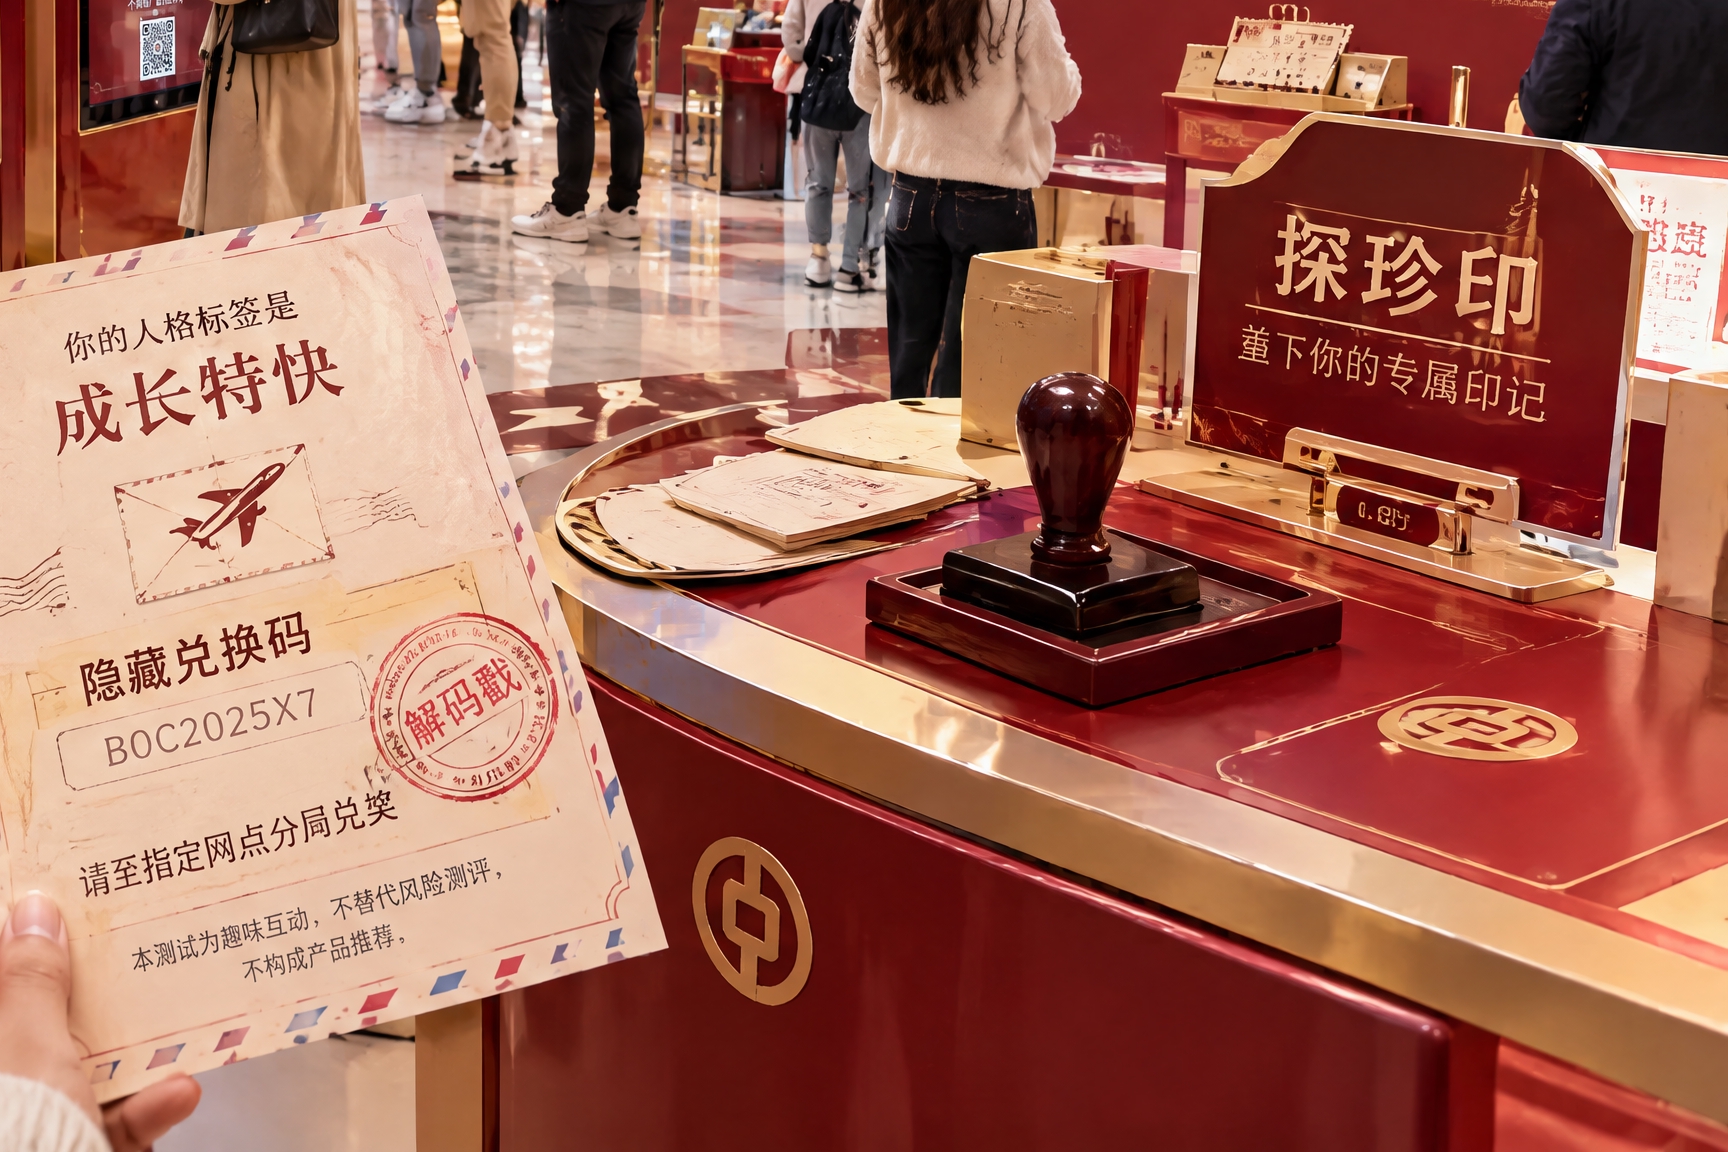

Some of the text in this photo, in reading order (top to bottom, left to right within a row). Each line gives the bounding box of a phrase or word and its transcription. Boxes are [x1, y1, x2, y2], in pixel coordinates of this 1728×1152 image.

[63, 290, 298, 364] 你的人格标签是
[1275, 213, 1538, 335] 探珍印
[55, 339, 345, 456] 成长特快
[79, 611, 312, 707] 隐藏兑换码
[78, 789, 398, 898] 请至指定网点分局兑奖
